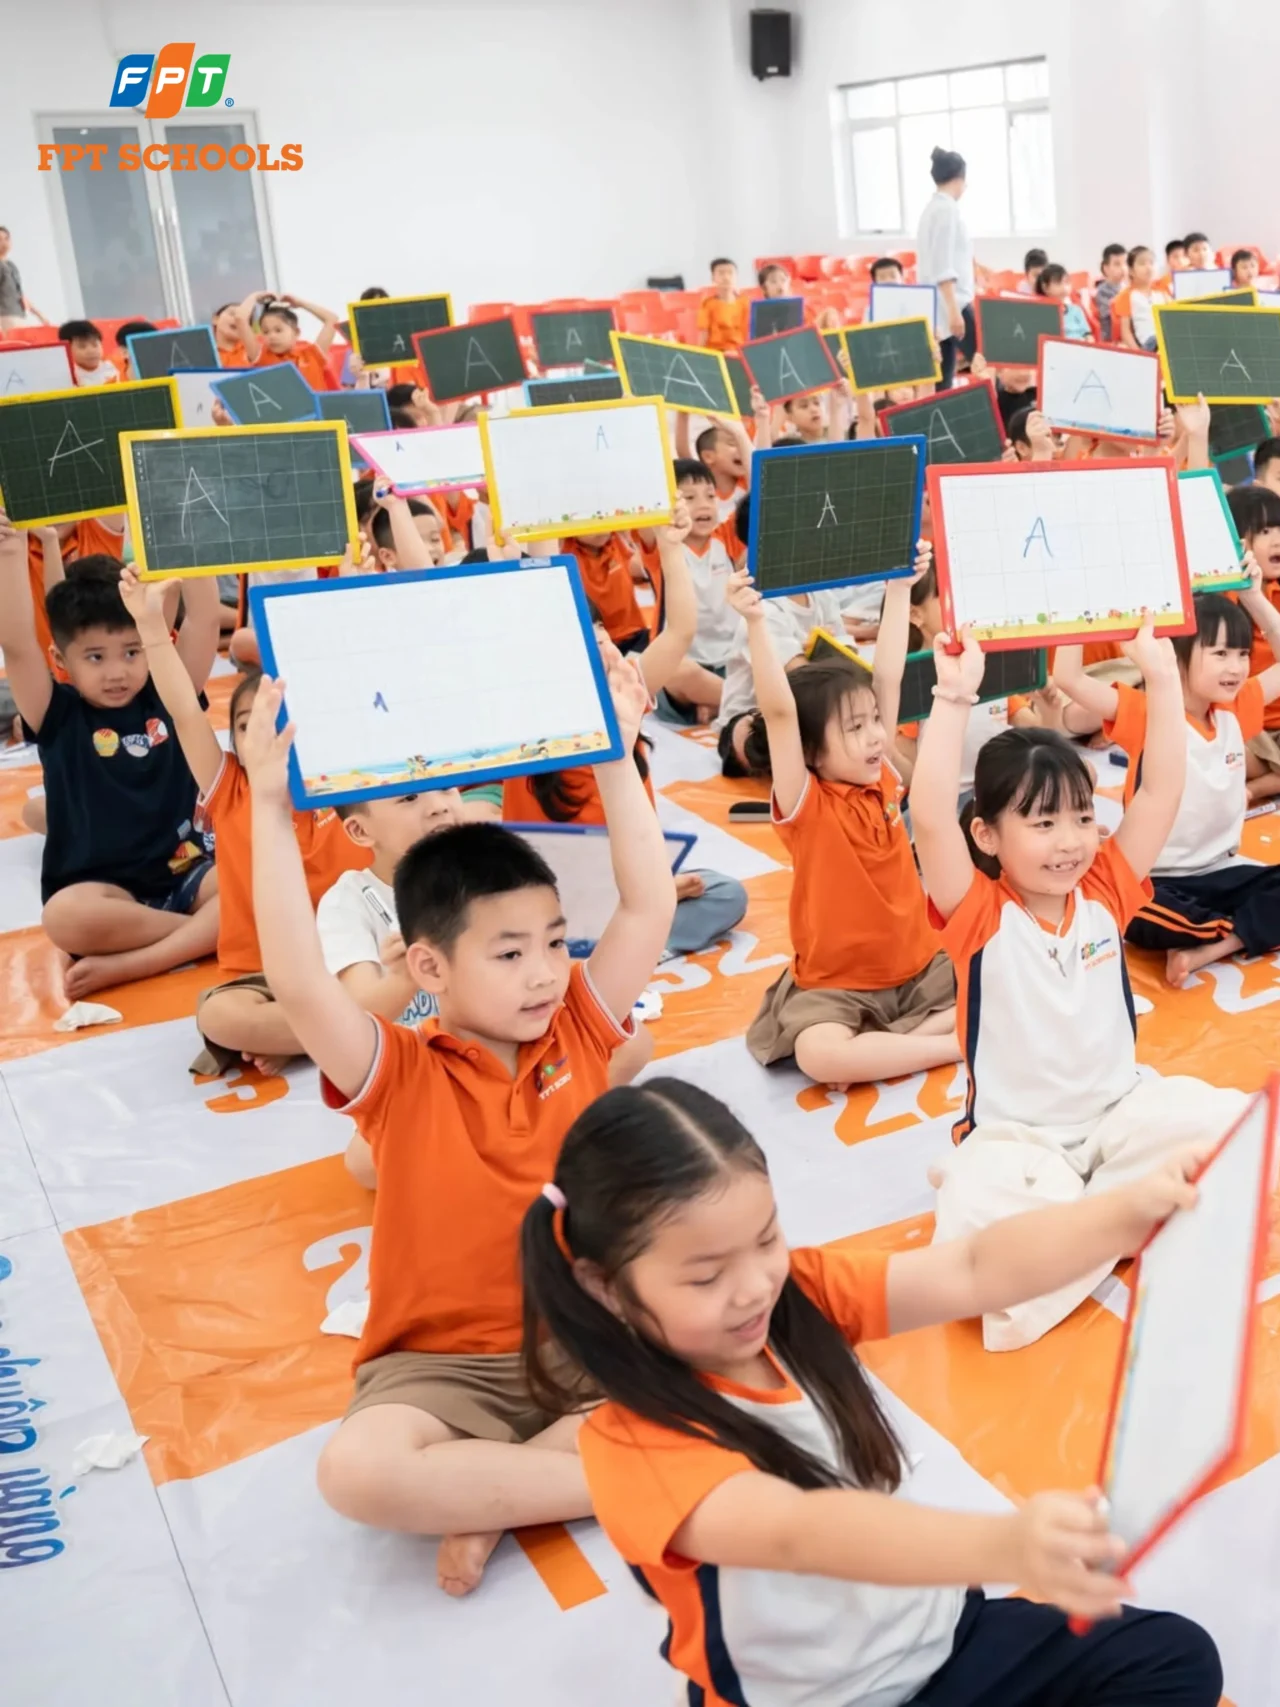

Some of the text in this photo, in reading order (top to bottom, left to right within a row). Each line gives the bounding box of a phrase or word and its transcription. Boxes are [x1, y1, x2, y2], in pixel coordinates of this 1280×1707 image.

[393, 334, 405, 352] A
[566, 327, 582, 351] A
[1012, 321, 1025, 341] A
[5, 369, 25, 392] A
[464, 336, 503, 387] A
[663, 353, 718, 408] A
[779, 346, 806, 394] A
[1220, 349, 1251, 382] A
[249, 382, 282, 417] A
[1073, 369, 1112, 410] A
[48, 419, 104, 478] A
[596, 425, 609, 450] A
[927, 407, 966, 464] A
[178, 466, 230, 541] A
[817, 492, 838, 529] A
[1024, 516, 1053, 558] A
